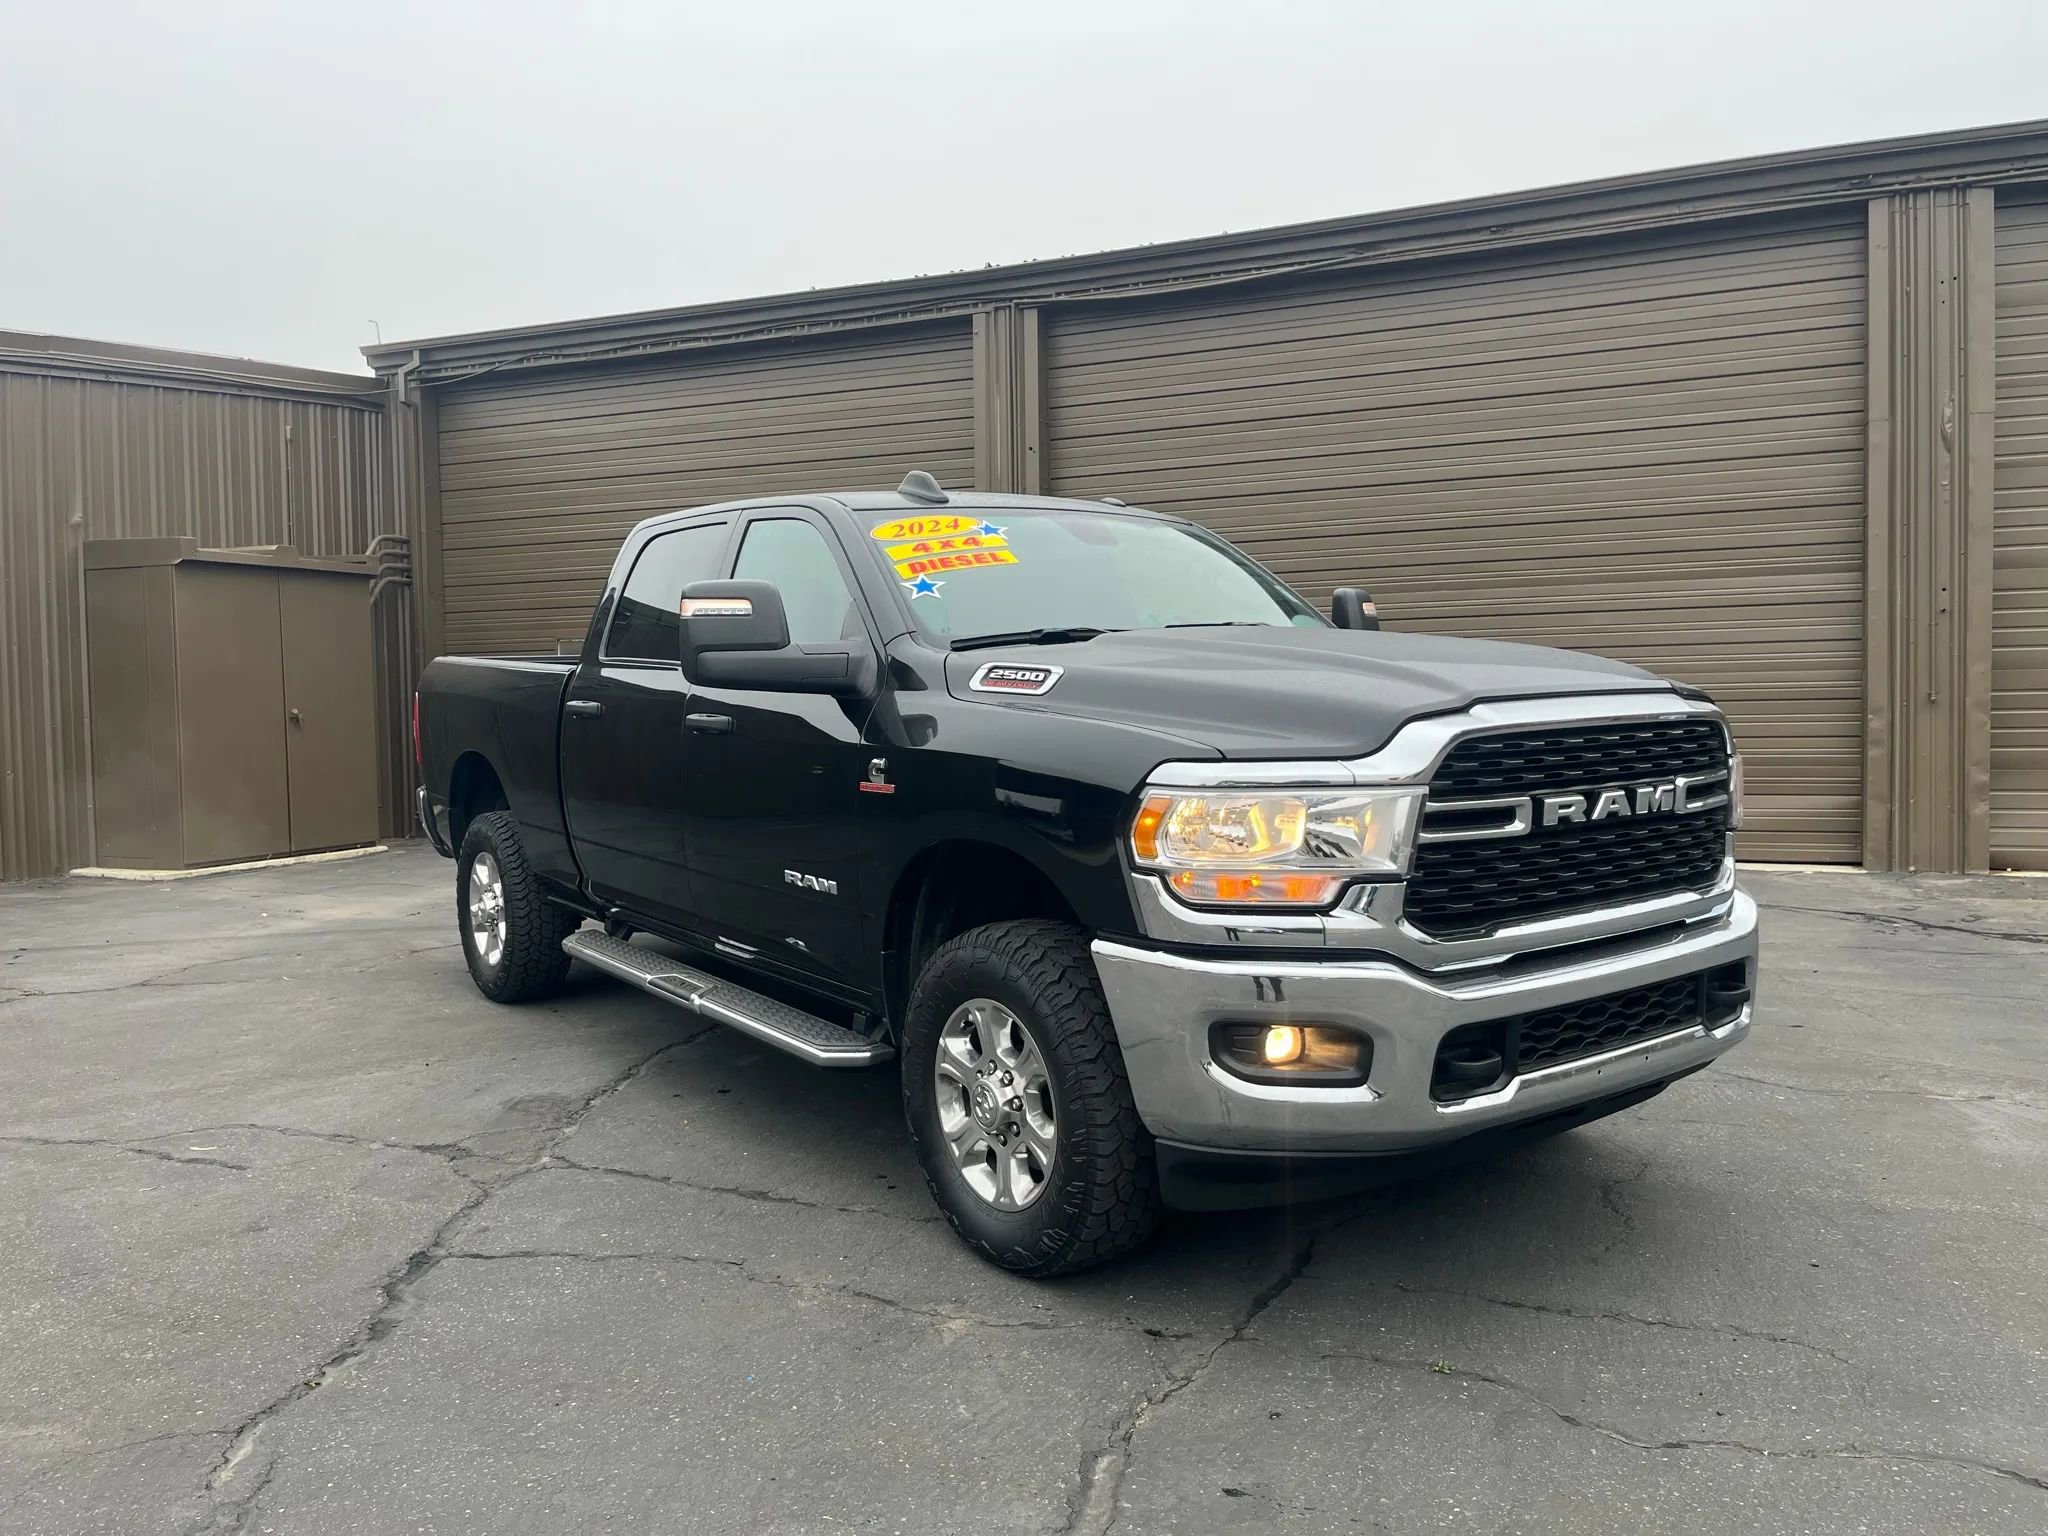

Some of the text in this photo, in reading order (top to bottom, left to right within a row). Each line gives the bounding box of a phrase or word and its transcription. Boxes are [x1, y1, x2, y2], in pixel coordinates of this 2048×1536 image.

[891, 518, 961, 539] 2024
[907, 552, 1009, 574] DIESEL
[989, 669, 1046, 682] 2500
[1543, 783, 1675, 826] RAM
[784, 869, 838, 895] RAM
